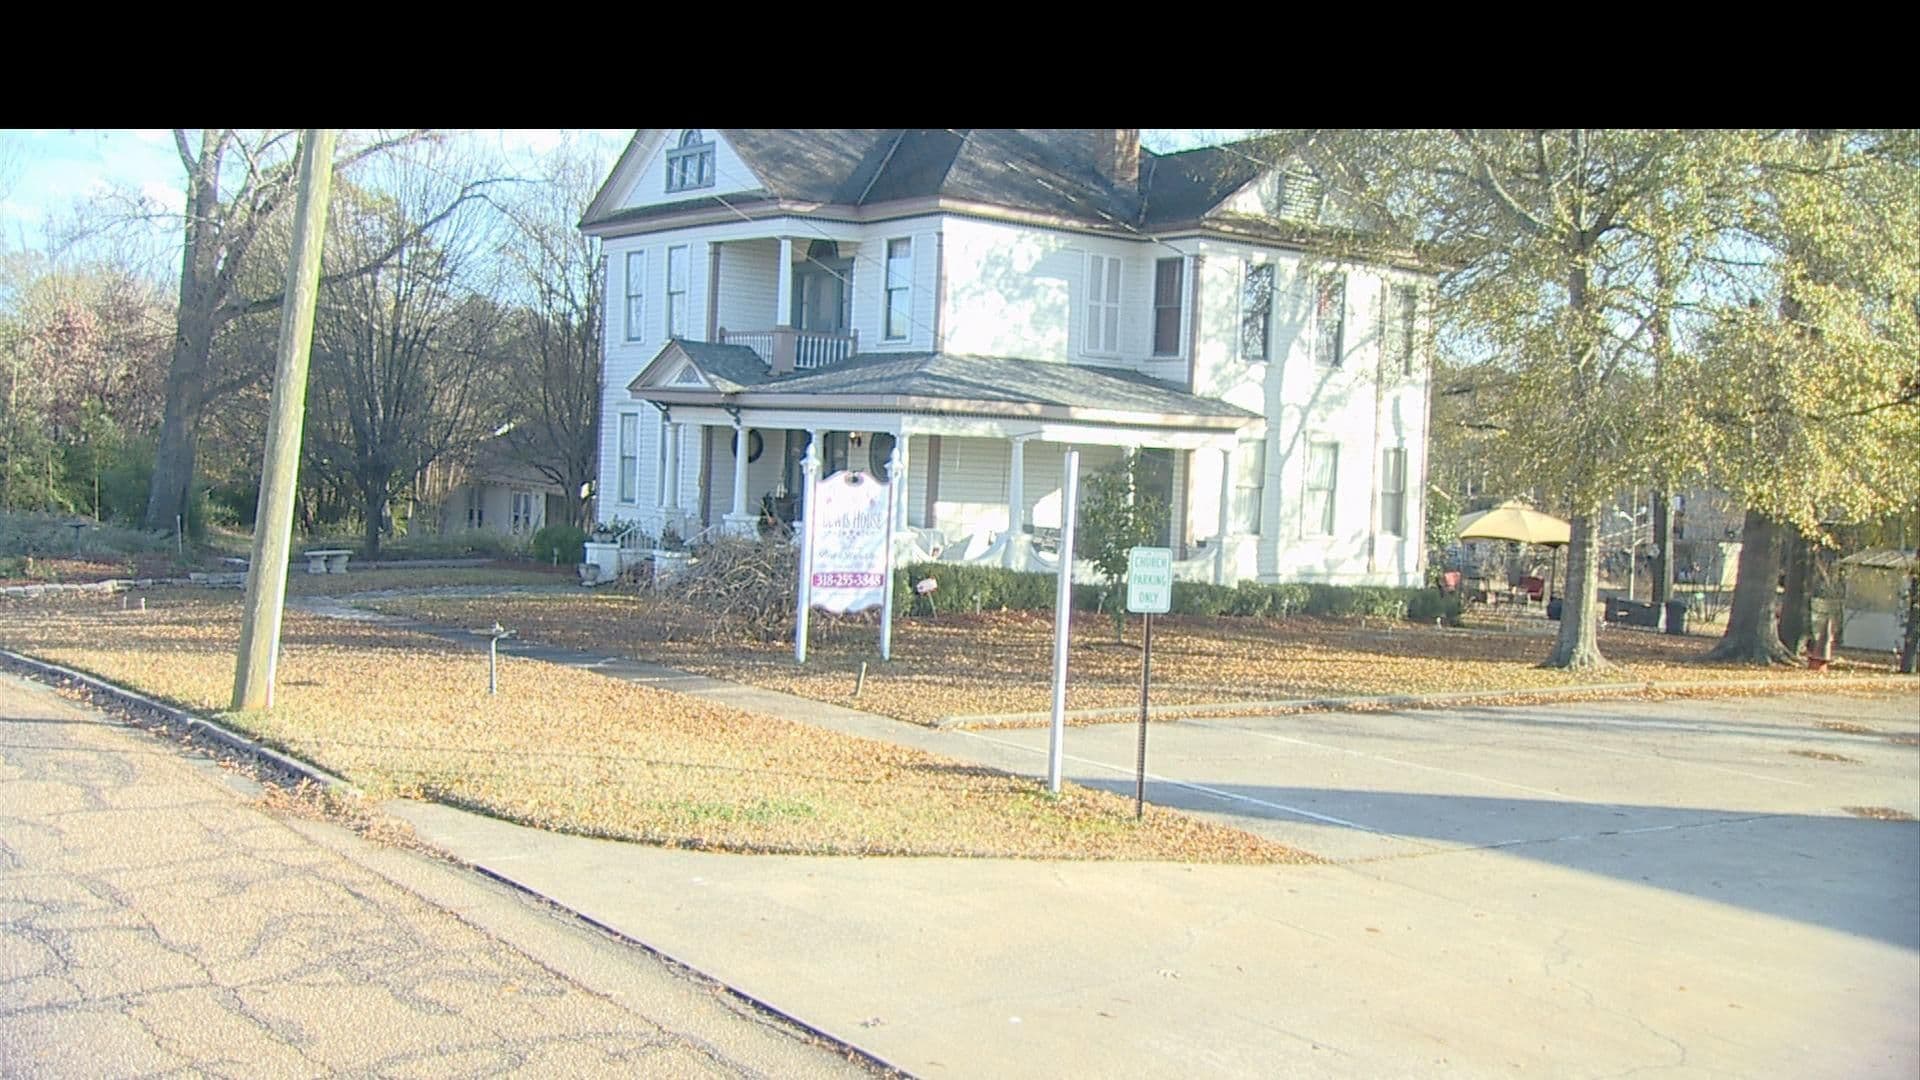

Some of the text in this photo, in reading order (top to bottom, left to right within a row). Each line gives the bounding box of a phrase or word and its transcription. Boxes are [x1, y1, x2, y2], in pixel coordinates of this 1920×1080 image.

[853, 510, 882, 529] HOUSE
[1134, 556, 1168, 568] CHURCH
[1133, 574, 1167, 586] PARKING
[1138, 591, 1160, 603] ONLY
